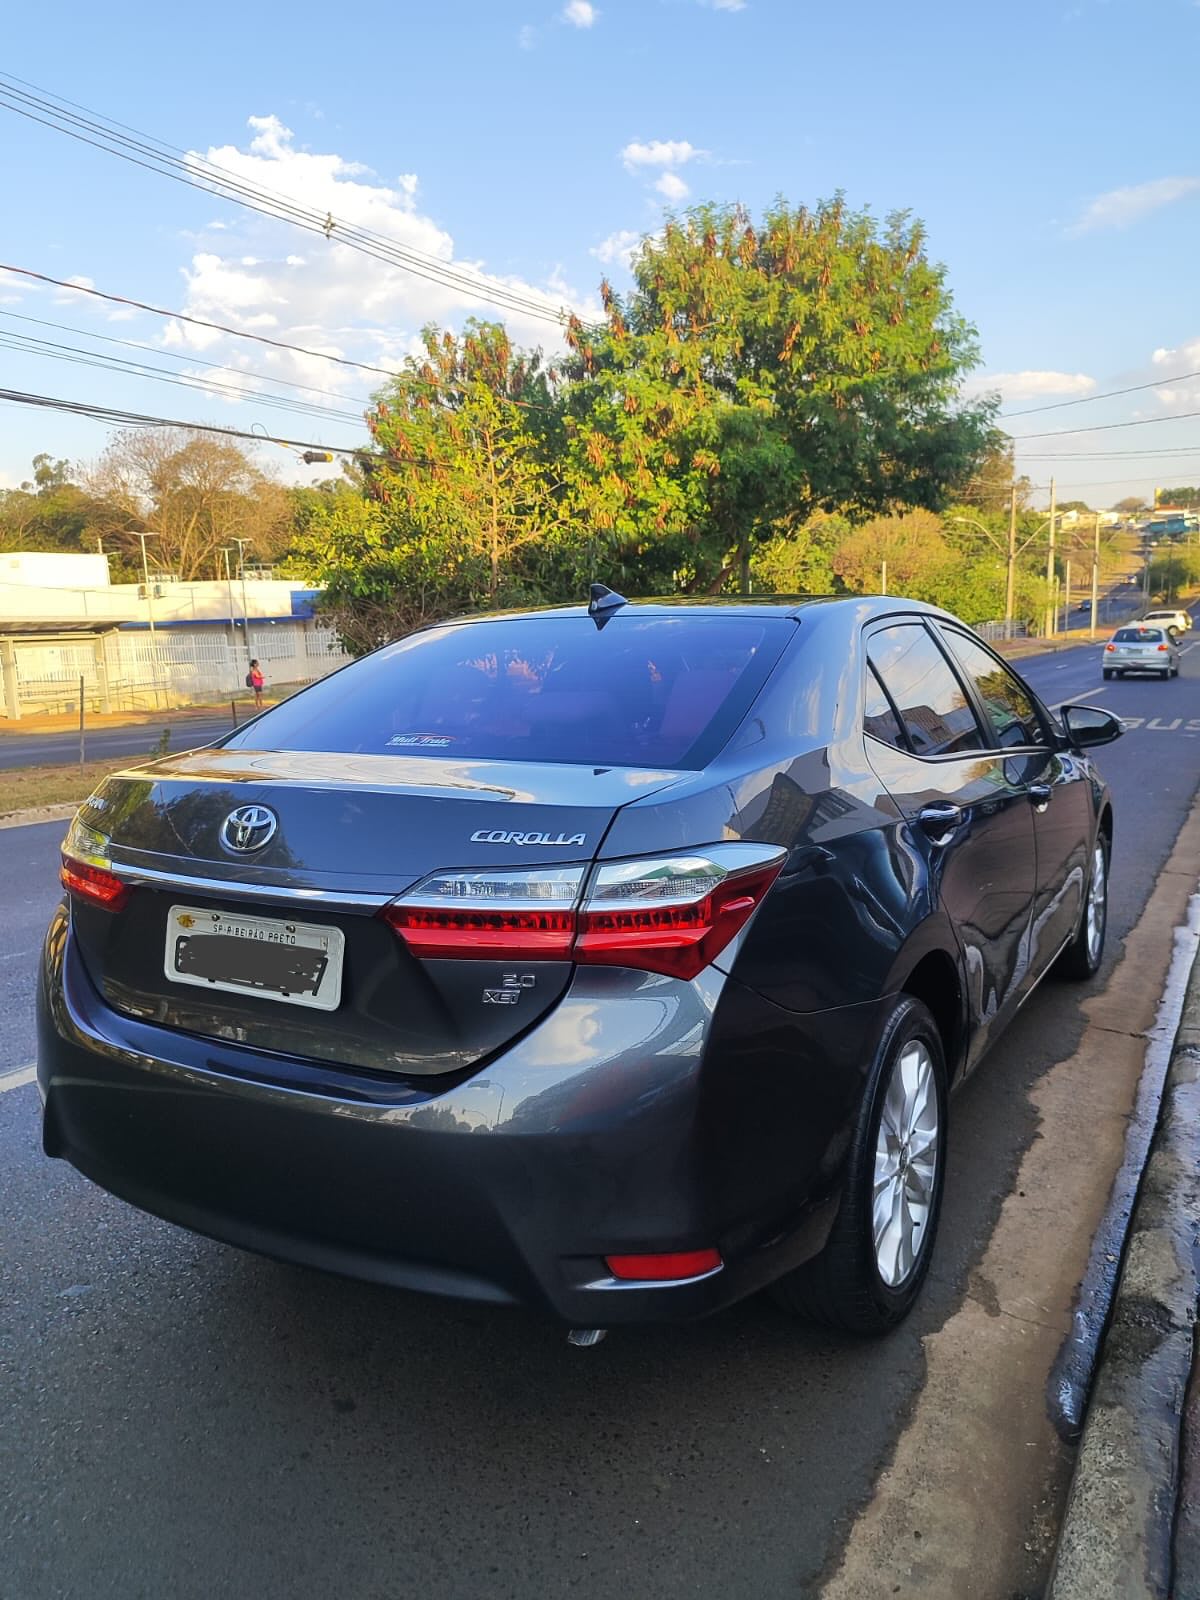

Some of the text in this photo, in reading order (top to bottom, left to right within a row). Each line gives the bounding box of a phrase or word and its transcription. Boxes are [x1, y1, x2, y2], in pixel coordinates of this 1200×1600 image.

[470, 830, 586, 846] COROLLA
[267, 932, 297, 945] PRETO
[503, 974, 535, 988] 2.0
